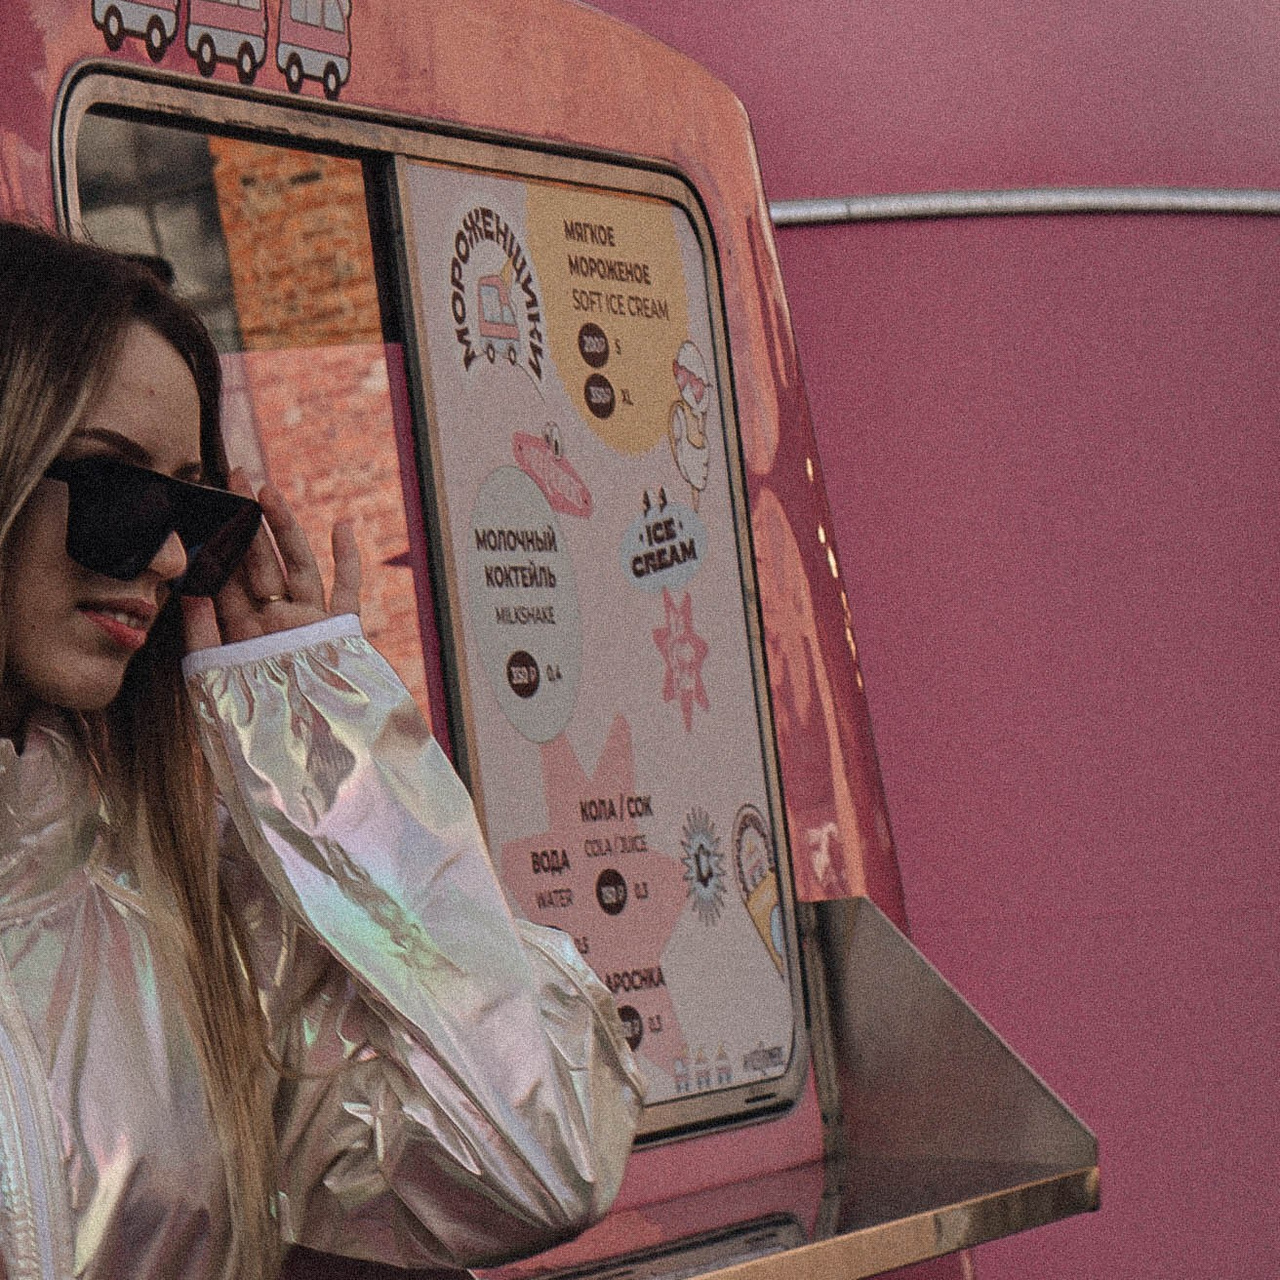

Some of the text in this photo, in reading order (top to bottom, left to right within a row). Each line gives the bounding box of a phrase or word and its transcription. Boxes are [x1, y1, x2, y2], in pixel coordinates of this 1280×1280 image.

[563, 218, 616, 248] МЯГКОЕ
[567, 254, 652, 286] МОРОЖЕНОЕ
[450, 206, 544, 382] МОРОЖЕНЩИКИ
[572, 287, 670, 321] SOFT ICE CREAM
[474, 525, 558, 552] МОЛОЧНЫЙ
[645, 517, 677, 546] ICE
[631, 538, 698, 578] CREAM
[484, 560, 557, 588] КОКТЕЙЛЬ
[495, 606, 556, 625] MILKSHAKE
[579, 798, 618, 822] КОЛА
[627, 795, 654, 819] СОК
[584, 838, 613, 858] COLA
[531, 849, 570, 876] ВОДА
[535, 888, 574, 909] WATER
